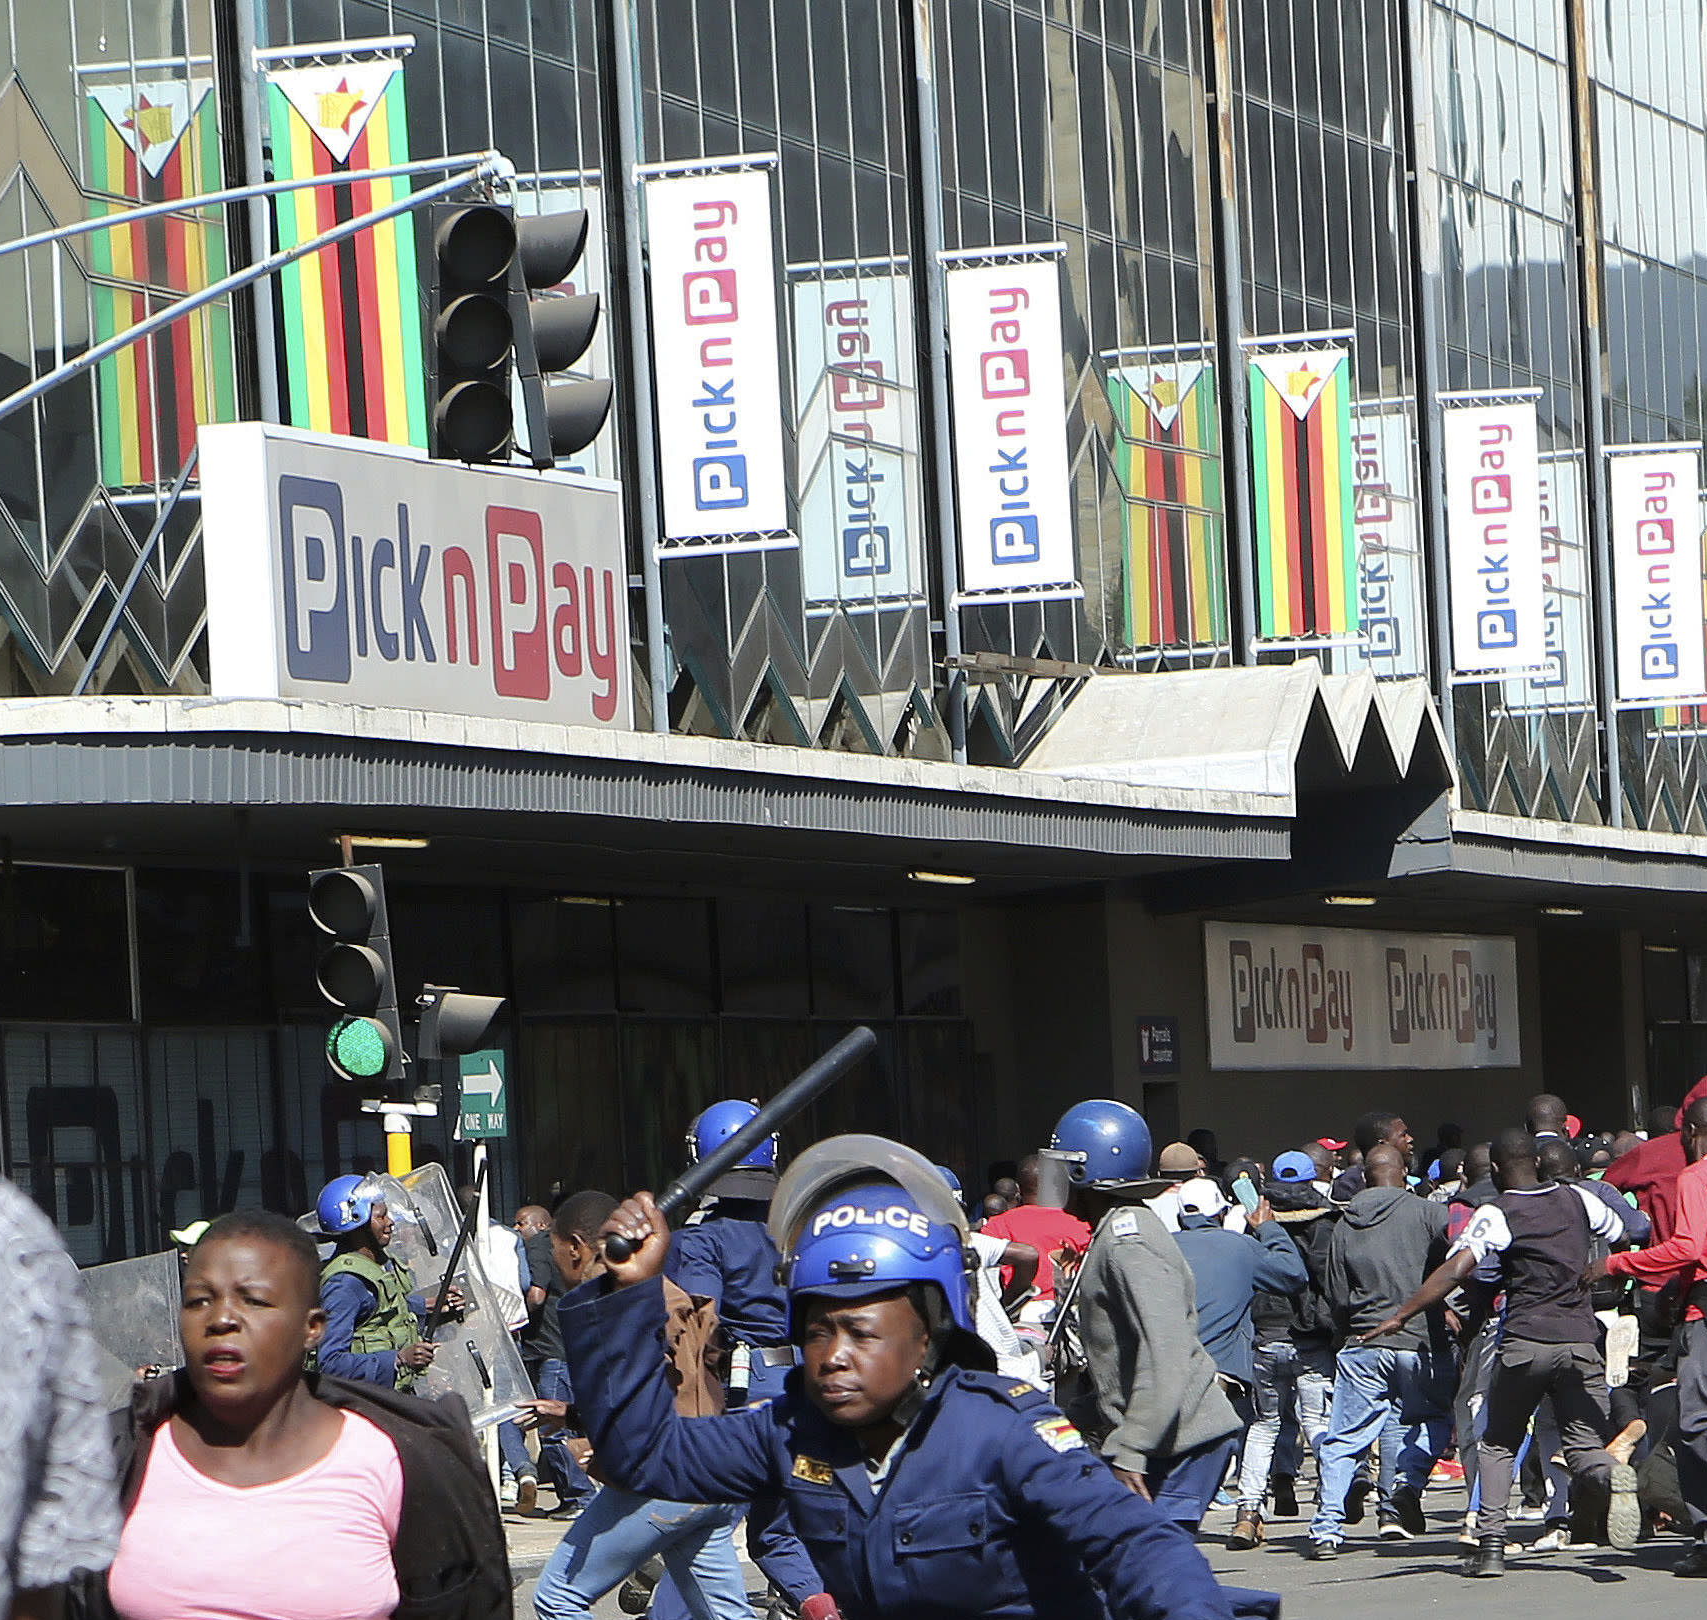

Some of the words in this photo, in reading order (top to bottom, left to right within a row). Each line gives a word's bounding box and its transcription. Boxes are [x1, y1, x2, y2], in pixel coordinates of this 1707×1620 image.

[683, 199, 738, 326] Pay
[699, 336, 733, 368] n
[979, 286, 1031, 400] Pay
[693, 377, 749, 511] Pick
[995, 408, 1026, 438] n
[1471, 423, 1513, 515] Pay
[988, 445, 1041, 566] Pick
[1483, 523, 1508, 545] n
[1636, 470, 1676, 557] Pay
[278, 474, 438, 684] Pick
[442, 546, 480, 666] n
[485, 503, 618, 722] Pay
[1476, 553, 1518, 650] Pick
[1647, 563, 1671, 584] n
[1641, 592, 1679, 681] Pick
[1229, 940, 1286, 1043] Pick
[1286, 967, 1301, 1029] n
[1301, 943, 1354, 1051] Pay
[1386, 947, 1437, 1044] Pick
[1437, 972, 1452, 1031] n
[1451, 950, 1498, 1050] Pay
[464, 1113, 481, 1130] ONE
[486, 1112, 504, 1129] WAY
[812, 1204, 930, 1238] POLICE
